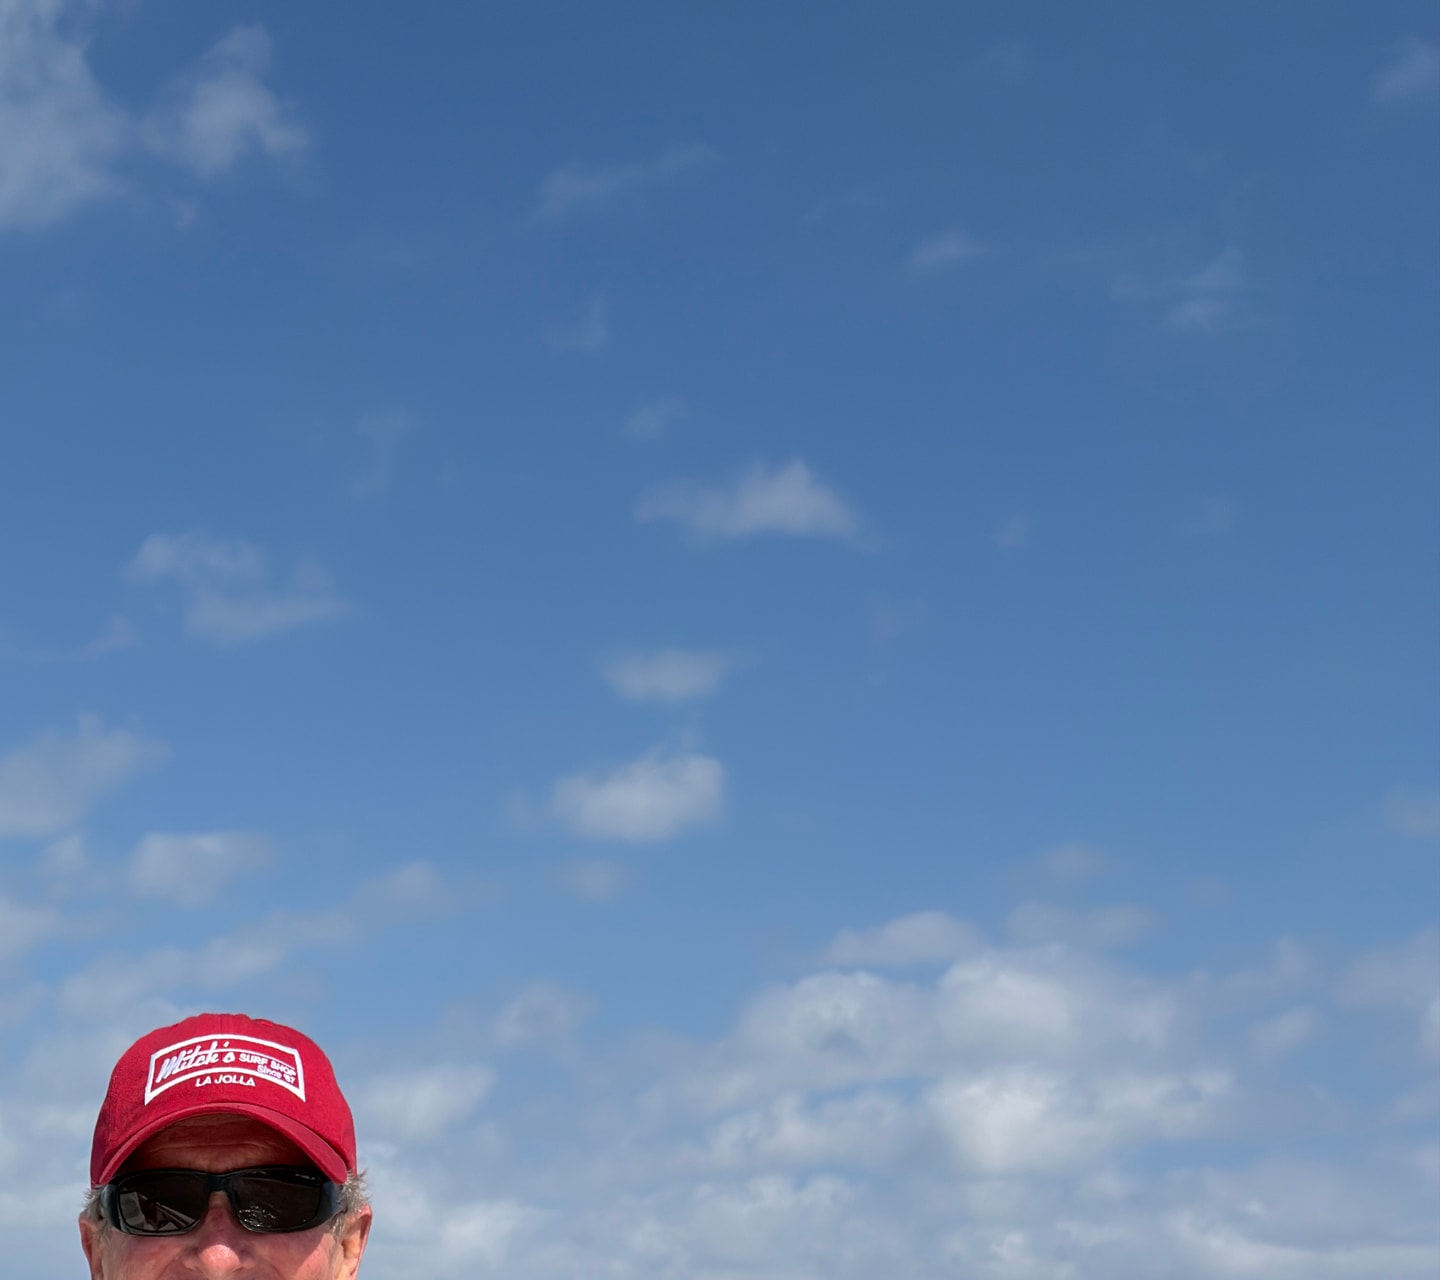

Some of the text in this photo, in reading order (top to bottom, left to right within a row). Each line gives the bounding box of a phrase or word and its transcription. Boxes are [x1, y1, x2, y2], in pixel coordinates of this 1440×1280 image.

[239, 1053, 268, 1065] SURF
[271, 1060, 296, 1076] SHOP
[195, 1075, 255, 1087] LA JOLLA
